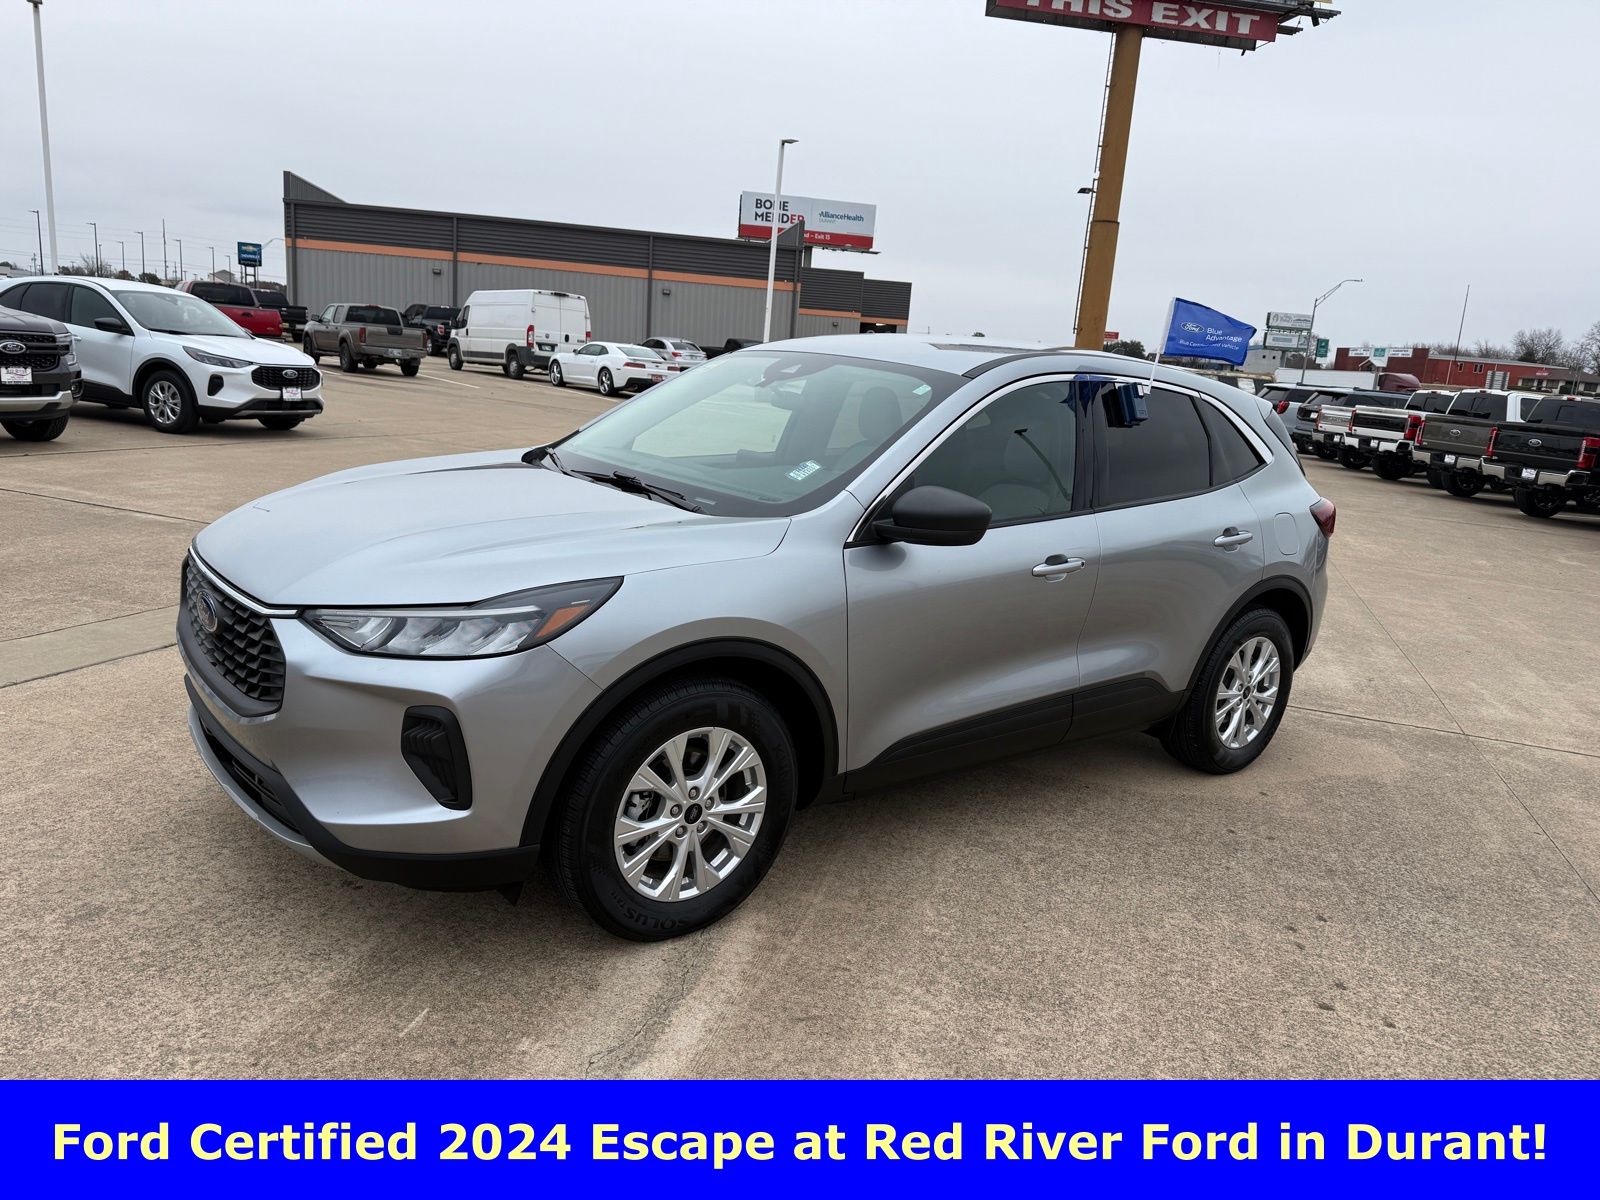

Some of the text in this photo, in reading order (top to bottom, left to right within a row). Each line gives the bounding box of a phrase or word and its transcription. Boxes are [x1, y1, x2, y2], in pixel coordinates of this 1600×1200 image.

[1026, 0, 1261, 34] HIS EXIT
[819, 210, 865, 222] AllianceHealth
[1206, 327, 1223, 335] Blue
[1205, 334, 1243, 343] Advantage
